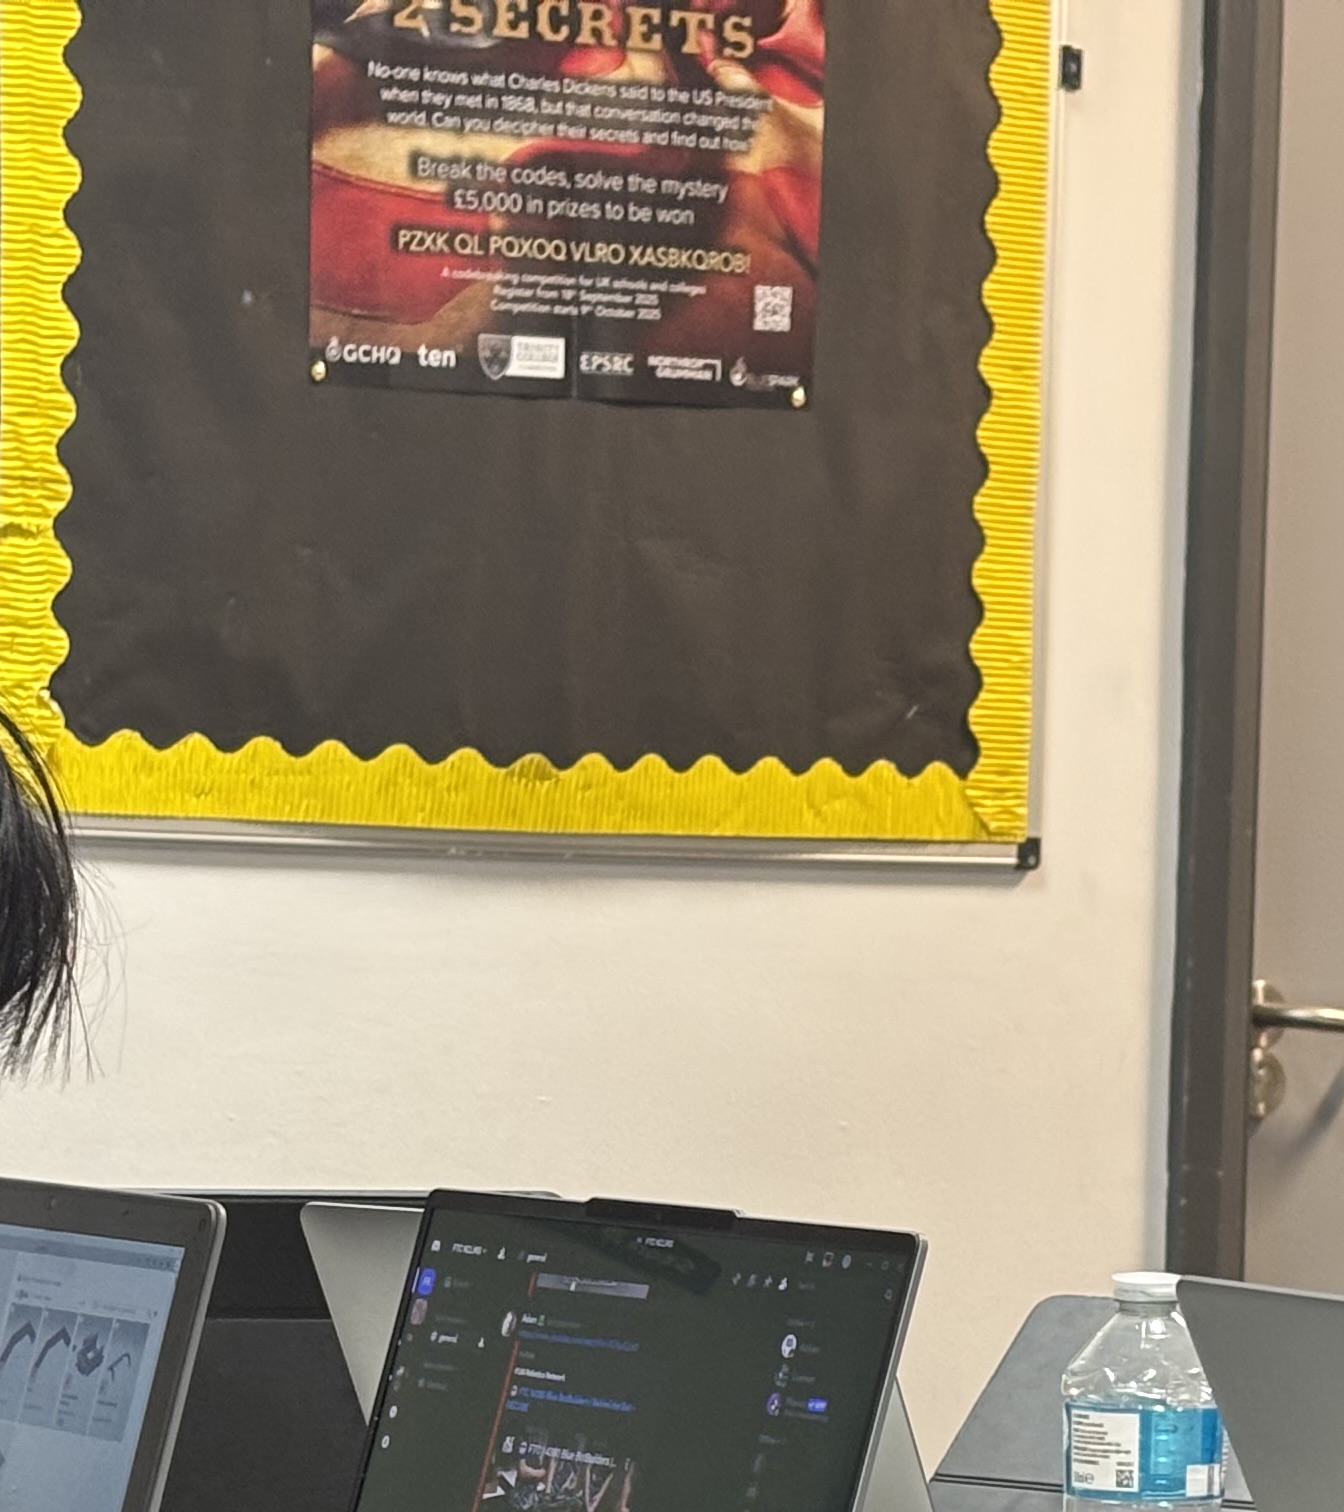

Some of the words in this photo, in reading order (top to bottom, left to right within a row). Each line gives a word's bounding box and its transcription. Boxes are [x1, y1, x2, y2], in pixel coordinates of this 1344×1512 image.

[449, 0, 755, 58] SECRETS
[367, 60, 421, 82] No-one
[423, 66, 469, 85] knows
[471, 70, 506, 88] what
[508, 73, 560, 93] Charles
[562, 78, 617, 97] Dickens
[619, 85, 649, 101] said
[650, 87, 665, 102] to
[667, 87, 690, 103] the
[692, 89, 713, 105] US
[379, 86, 419, 103] when
[421, 90, 453, 109] they
[454, 93, 482, 109] met
[485, 94, 499, 109] in
[541, 99, 563, 115] but
[565, 101, 591, 117] that
[593, 106, 681, 124] conversation
[682, 111, 740, 131] changed
[431, 112, 461, 129] Can
[463, 119, 491, 134] you
[493, 119, 555, 136] decipher
[557, 122, 587, 138] their
[589, 128, 640, 144] secrets
[642, 130, 669, 146] and
[670, 131, 697, 148] find
[699, 135, 721, 150] out
[417, 157, 472, 179] Break
[476, 162, 506, 183] the
[510, 166, 572, 189] codes,
[574, 170, 624, 192] solve
[627, 173, 657, 194] the
[660, 178, 729, 204] mystery
[454, 188, 523, 213] £5,000
[526, 195, 543, 213] in
[547, 197, 602, 219] prizes
[605, 200, 624, 220] to
[627, 202, 653, 222] be
[656, 208, 695, 225] won
[398, 229, 450, 253] PZXK
[454, 233, 484, 255] QL
[489, 236, 567, 261] PQXOQ
[570, 241, 625, 265] VLRO
[343, 343, 401, 365] GCHQ
[417, 343, 456, 368] ten
[579, 353, 634, 374] EPSRC
